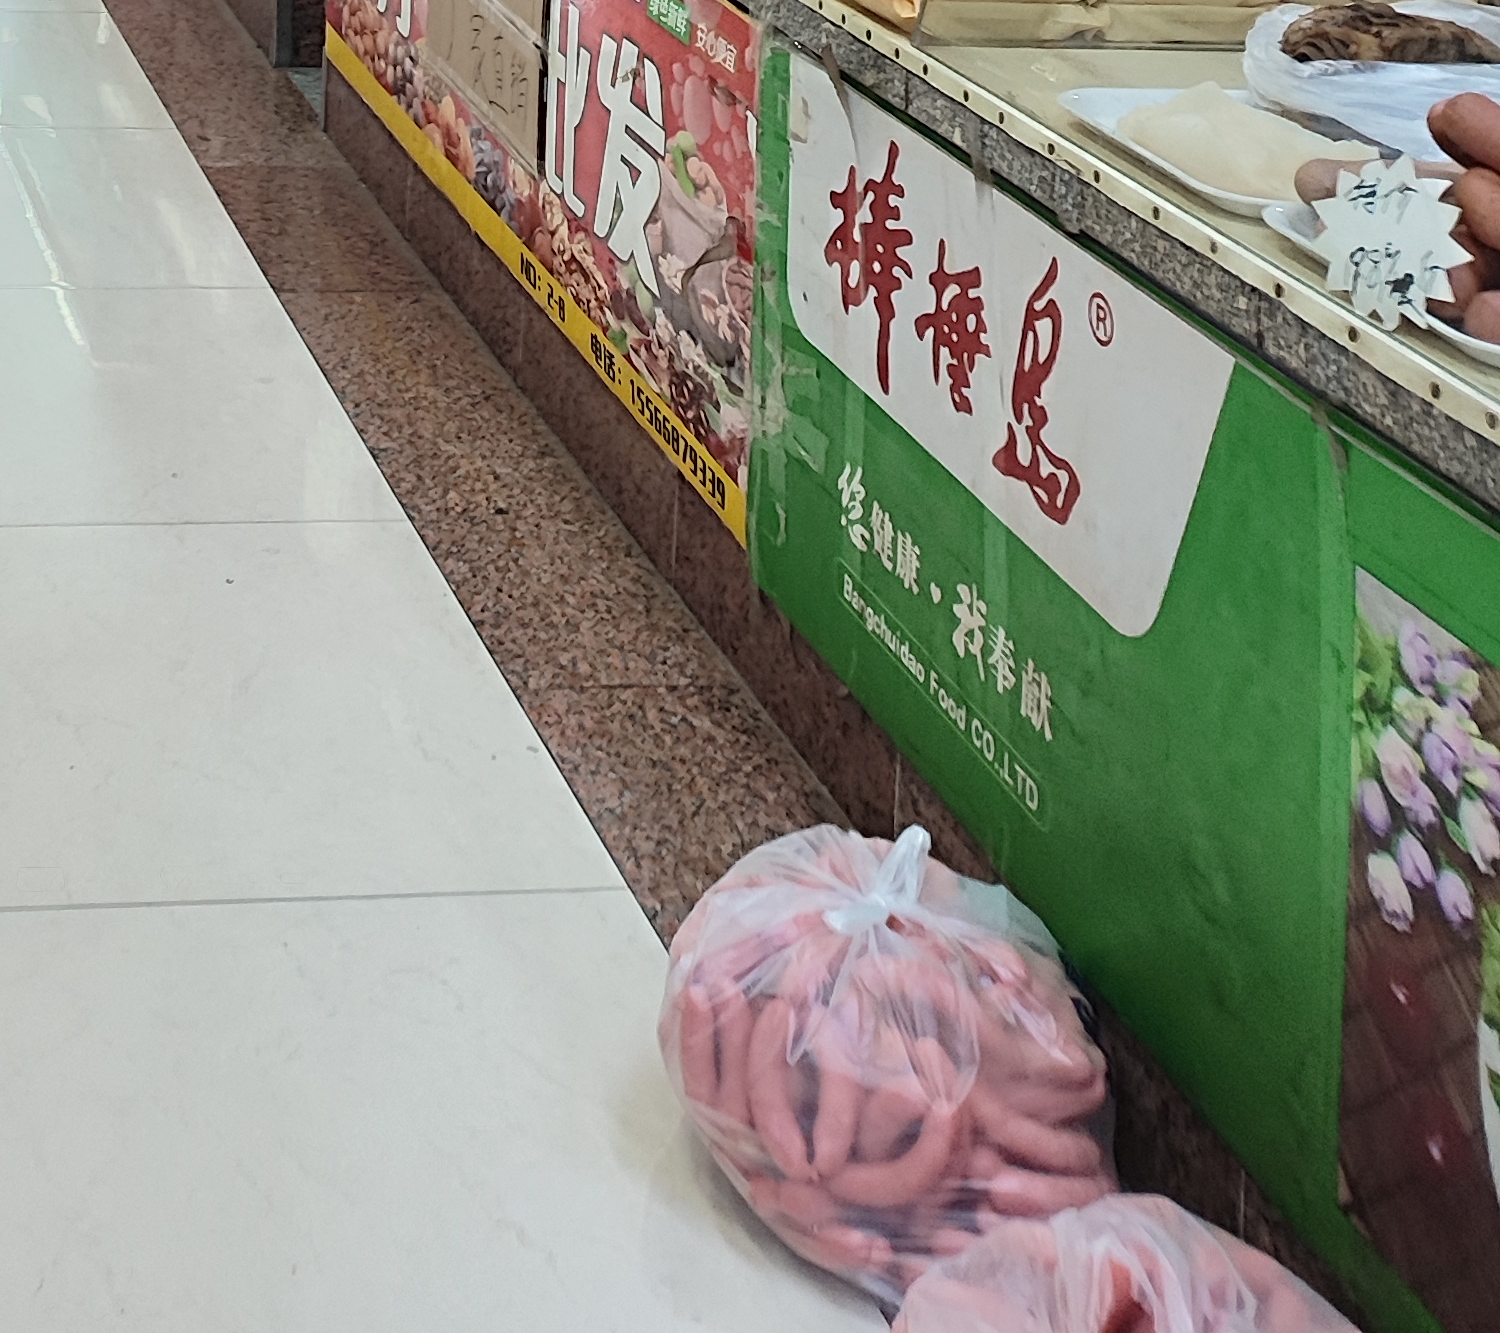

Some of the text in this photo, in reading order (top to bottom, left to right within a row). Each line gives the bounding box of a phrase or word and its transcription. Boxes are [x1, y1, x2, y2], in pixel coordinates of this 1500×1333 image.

[694, 23, 738, 74] 安心便宜
[842, 573, 925, 684] Bangchuidao
[929, 669, 967, 731] Food
